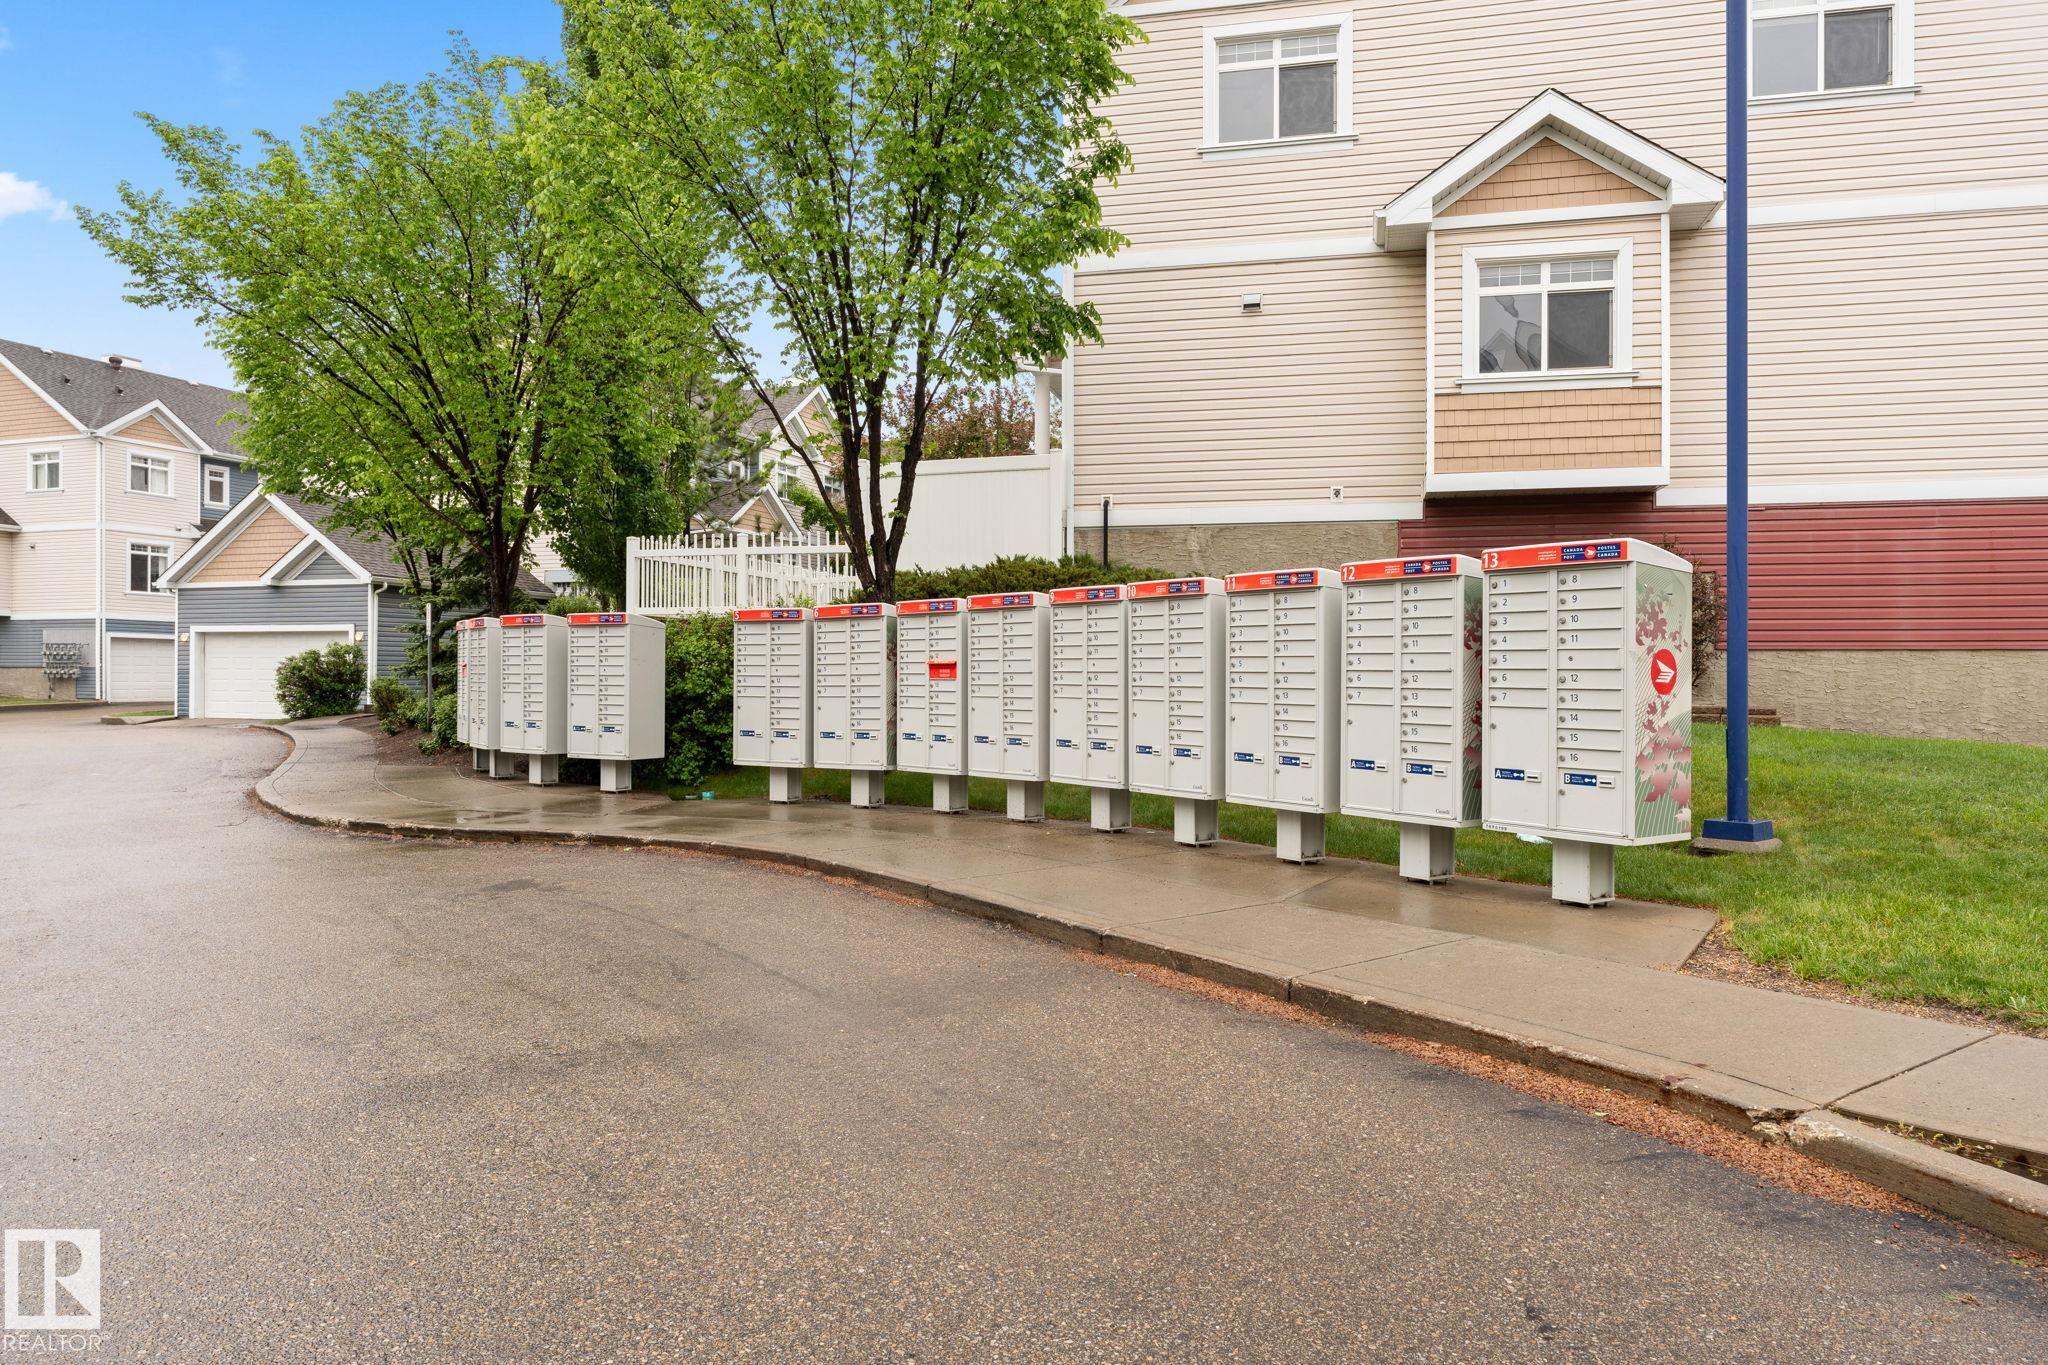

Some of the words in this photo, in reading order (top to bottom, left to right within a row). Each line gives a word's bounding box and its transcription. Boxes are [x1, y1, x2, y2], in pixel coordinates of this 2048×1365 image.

[1482, 552, 1499, 569] 13
[1342, 566, 1356, 580] 12
[1226, 577, 1236, 590] 11
[1503, 579, 1507, 587] 1
[1571, 574, 1578, 584] 8
[1127, 585, 1137, 598] 10
[1413, 586, 1418, 594] 8
[1502, 598, 1508, 607] 2
[1571, 594, 1578, 604] 9
[1357, 606, 1362, 615] 2
[1413, 604, 1418, 612] 9
[734, 612, 740, 620] 5
[814, 609, 819, 618] 6
[1502, 616, 1508, 625] 3
[1570, 614, 1579, 623] 10
[1357, 623, 1362, 631] 3
[1412, 621, 1419, 630] 10
[1501, 635, 1507, 643] 4
[1570, 634, 1578, 643] 11
[1357, 657, 1362, 665] 5
[1502, 654, 1508, 663] 5
[1356, 674, 1362, 682] 6
[1411, 674, 1419, 683] 12
[1501, 673, 1508, 682] 6
[1570, 673, 1579, 683] 12
[1357, 691, 1362, 699] 7
[1411, 692, 1419, 701] 13
[1502, 692, 1507, 701] 7
[1570, 693, 1579, 703] 13
[1570, 713, 1579, 722] 14
[1411, 727, 1418, 736] 15
[1569, 733, 1579, 742] 15
[1411, 745, 1418, 753] 16
[1569, 753, 1579, 762] 16
[1495, 769, 1502, 778] A
[1565, 774, 1571, 783] B
